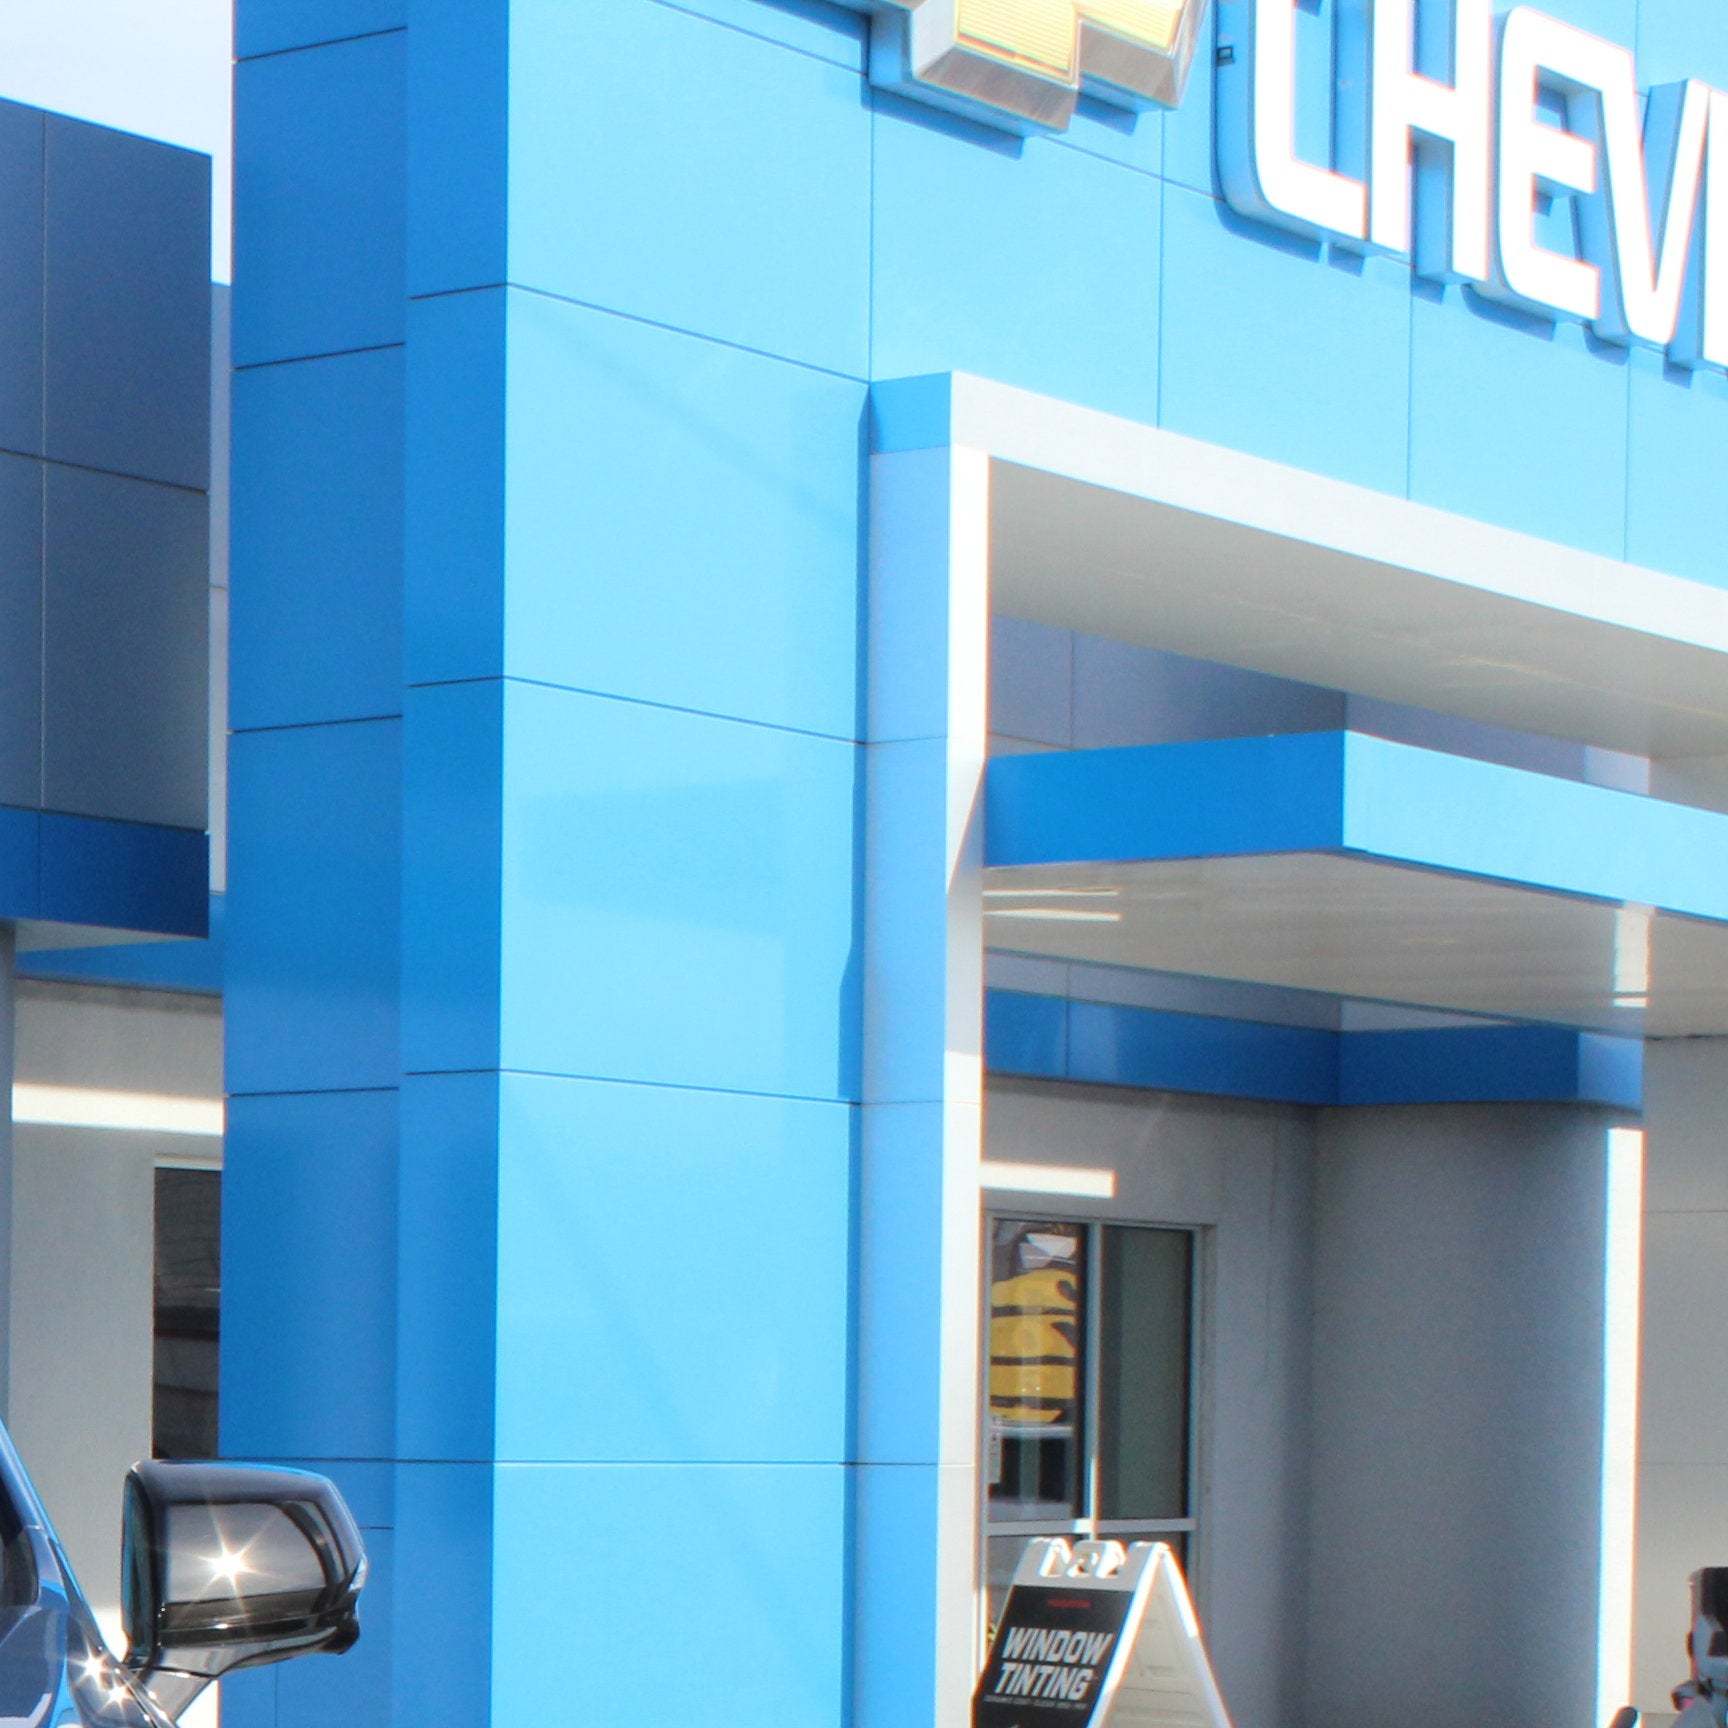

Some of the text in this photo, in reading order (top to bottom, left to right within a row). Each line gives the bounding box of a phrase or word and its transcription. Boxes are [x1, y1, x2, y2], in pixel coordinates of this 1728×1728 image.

[1244, 0, 1728, 367] CHEV
[1001, 1626, 1115, 1666] WINDOW
[994, 1661, 1094, 1701] TINTING
